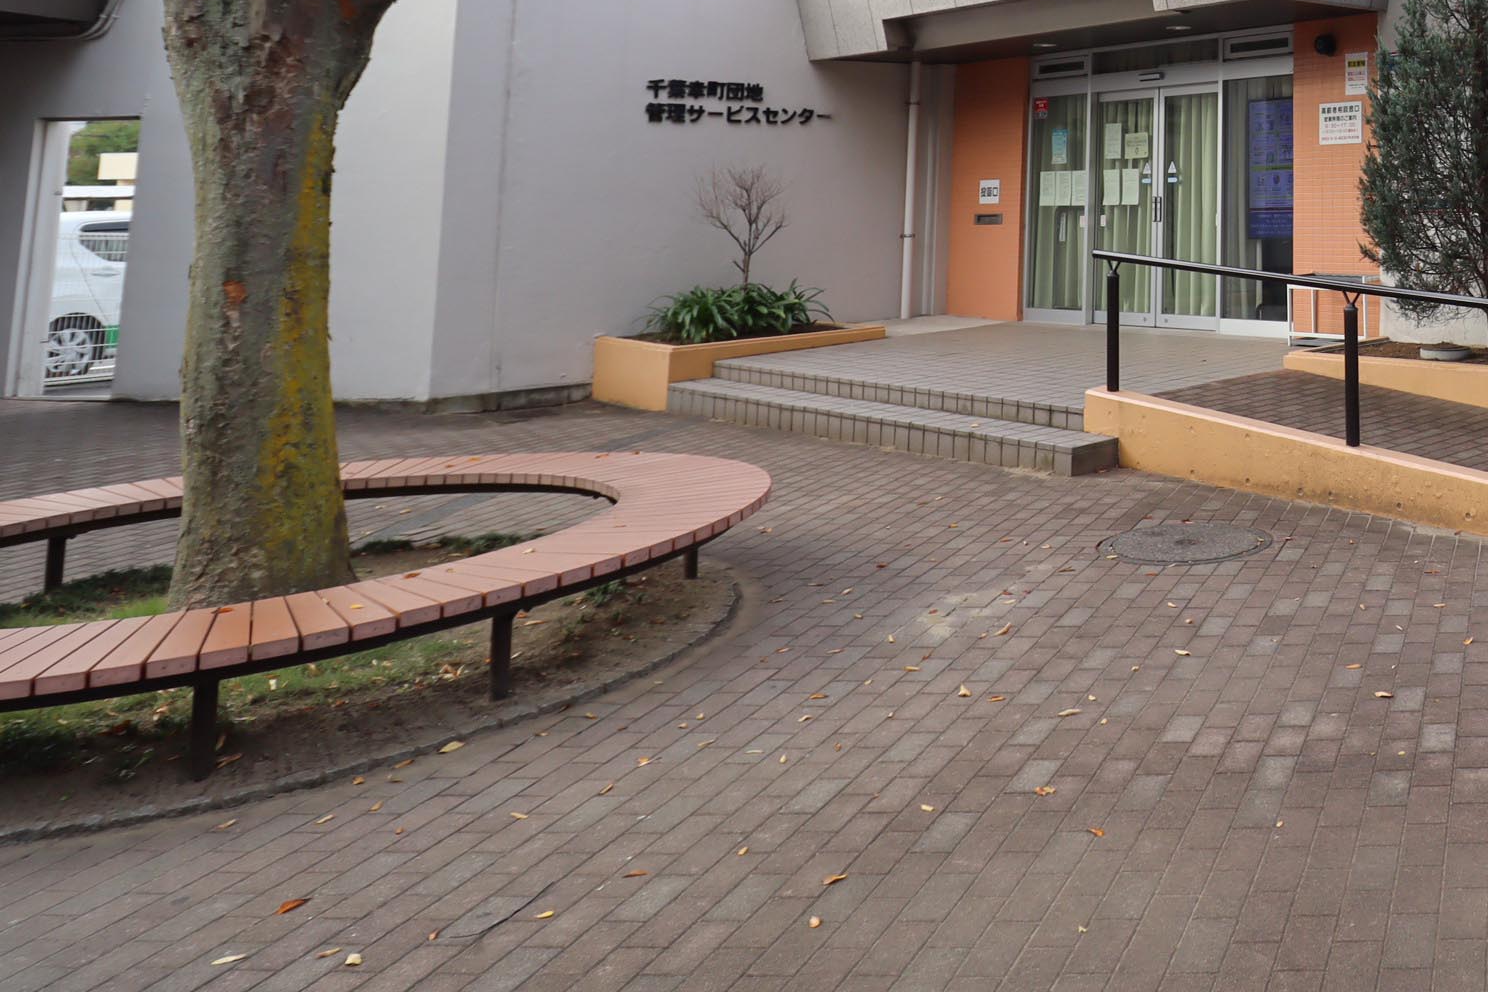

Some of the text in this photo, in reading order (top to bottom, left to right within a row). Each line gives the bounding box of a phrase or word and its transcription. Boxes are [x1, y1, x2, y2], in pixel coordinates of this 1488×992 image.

[646, 79, 764, 102] 千葉幸町団地
[645, 102, 832, 125] 管理サービスセンター
